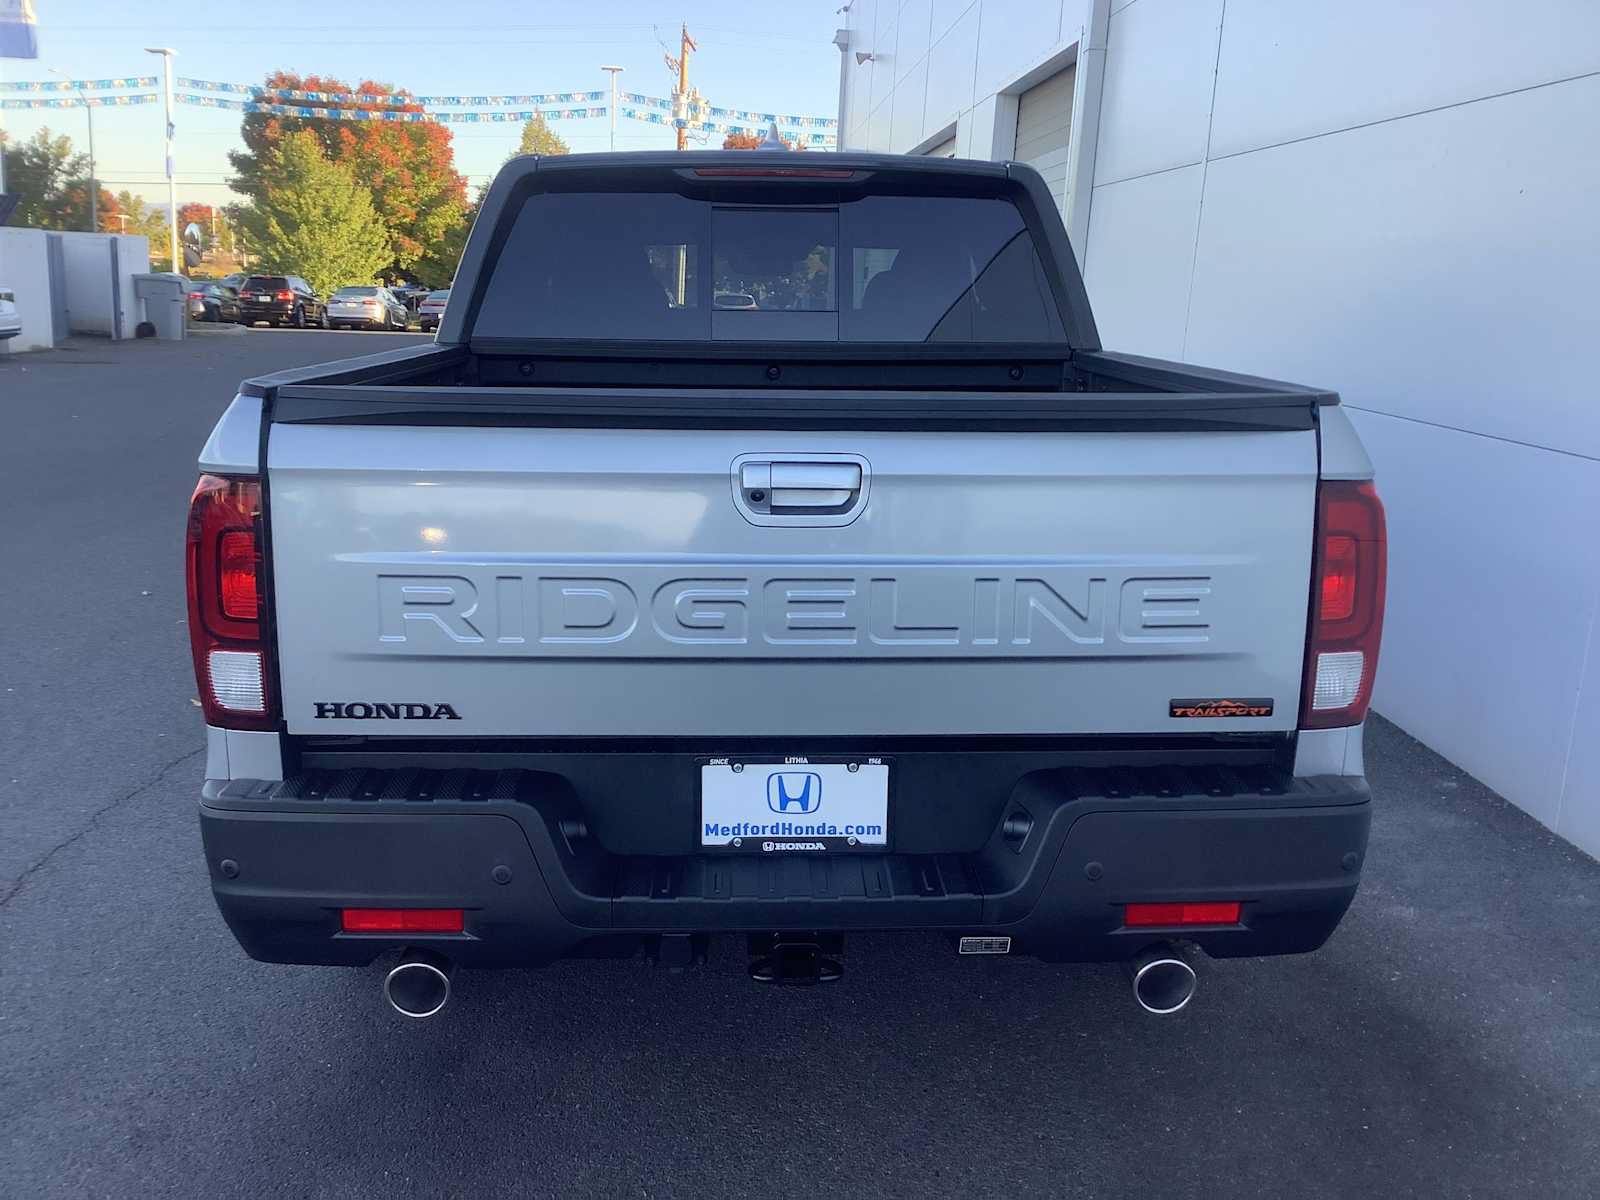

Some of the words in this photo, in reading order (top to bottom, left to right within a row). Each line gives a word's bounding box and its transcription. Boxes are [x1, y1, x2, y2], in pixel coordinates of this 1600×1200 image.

[376, 574, 1213, 646] RIDGELINE
[313, 702, 463, 720] HONDA
[1173, 707, 1271, 717] TRAILSPORT
[705, 822, 882, 836] MedfordHonda.com
[774, 842, 826, 850] HONDA
